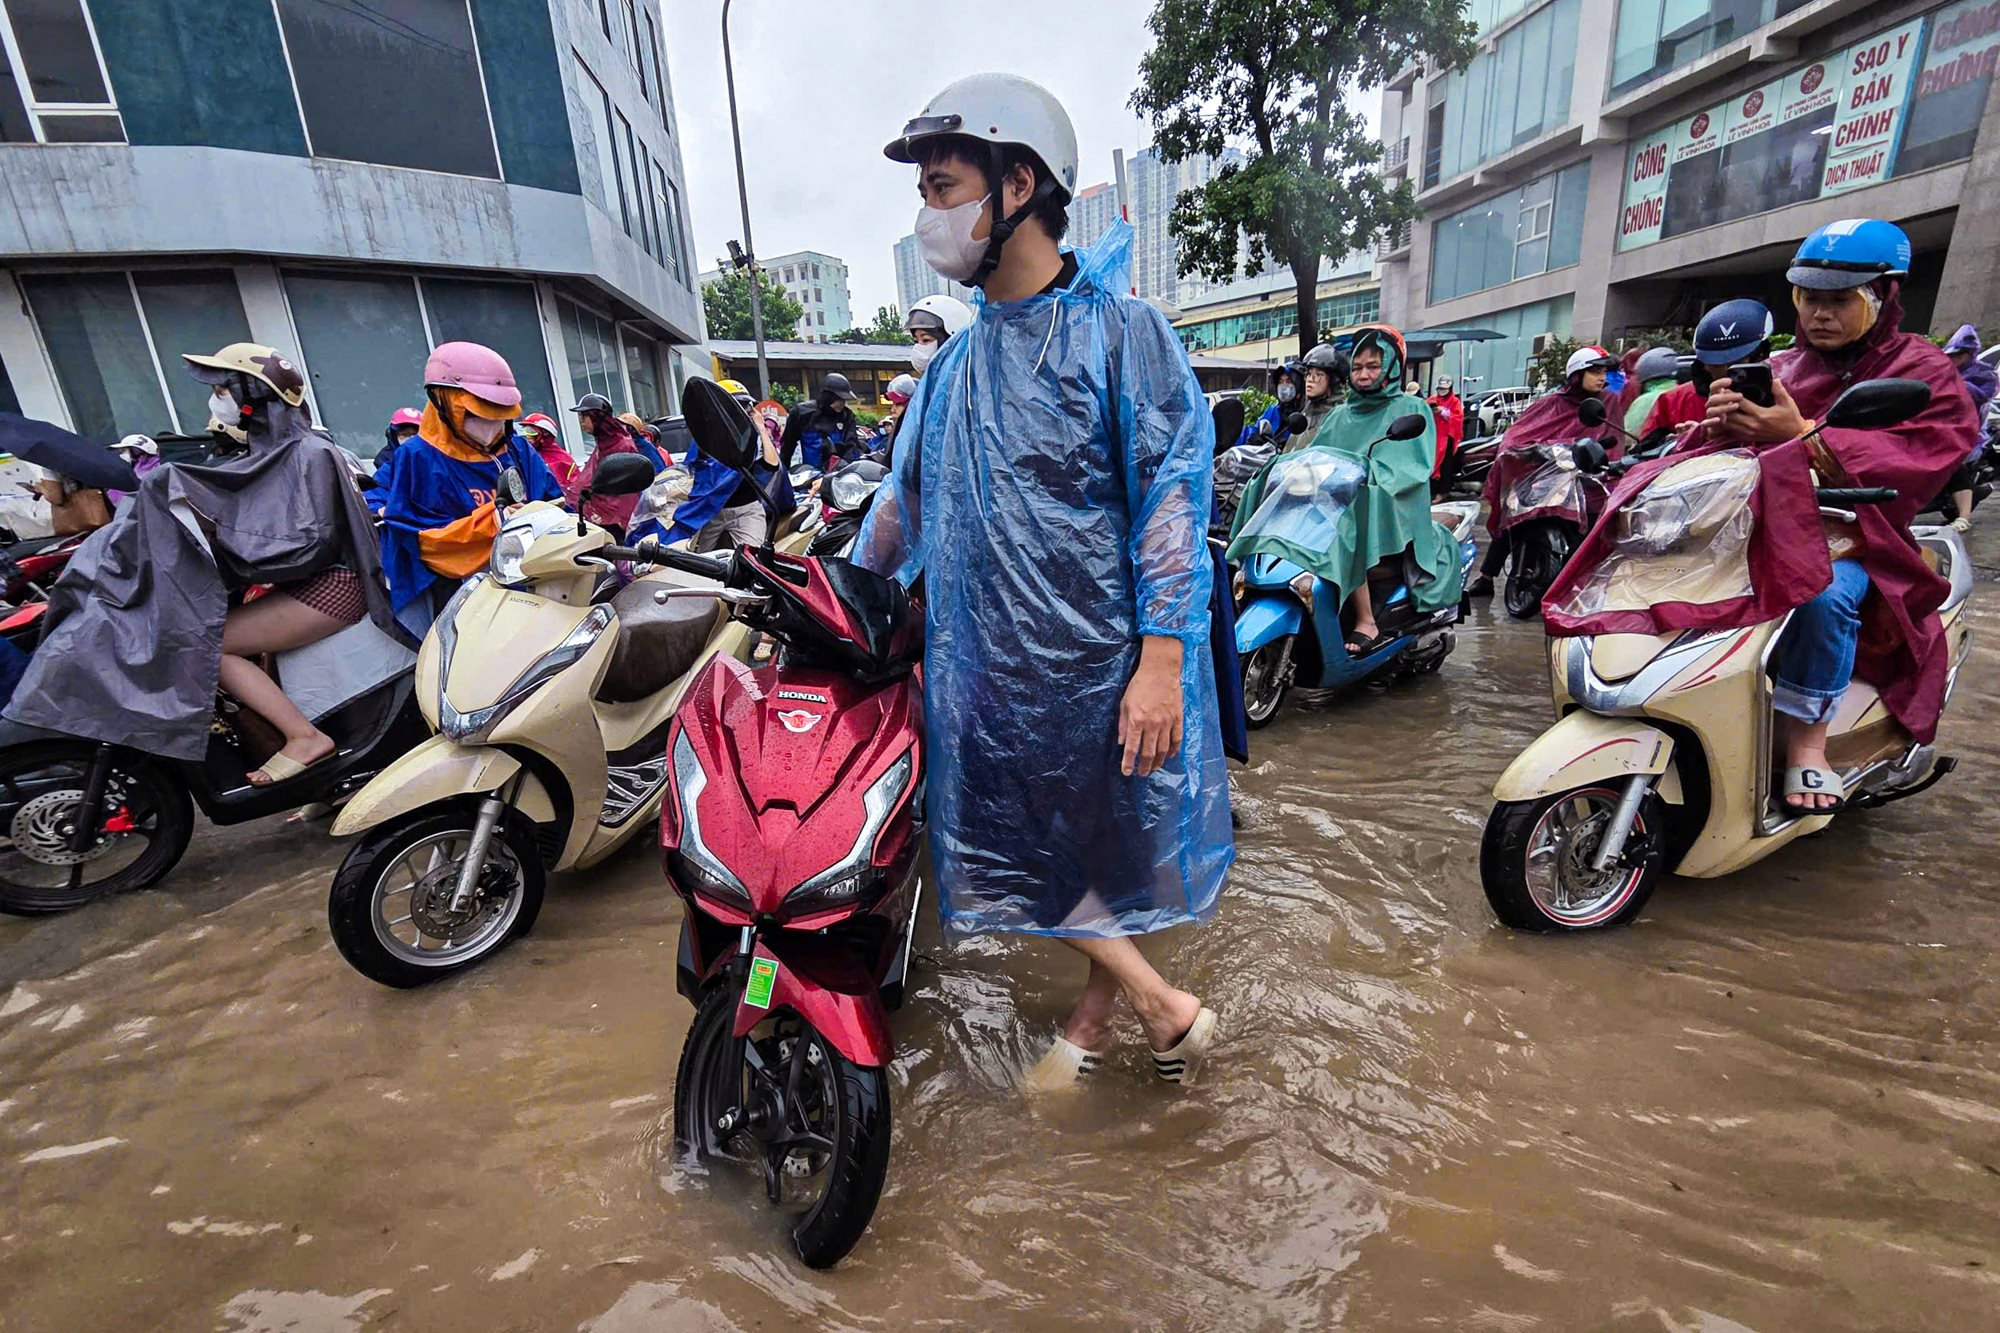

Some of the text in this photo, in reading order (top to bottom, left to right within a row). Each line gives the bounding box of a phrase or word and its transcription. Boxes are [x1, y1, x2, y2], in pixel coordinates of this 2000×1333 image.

[1852, 32, 1911, 76] SAO Y
[1851, 72, 1893, 110] BẢN
[1835, 108, 1894, 147] CHÍNH
[1633, 143, 1667, 182] CÔNG
[1825, 150, 1884, 189] DỊCH THUẬT
[1623, 195, 1662, 235] CHỨNG
[778, 691, 827, 703] HONDA
[1801, 769, 1824, 788] G
